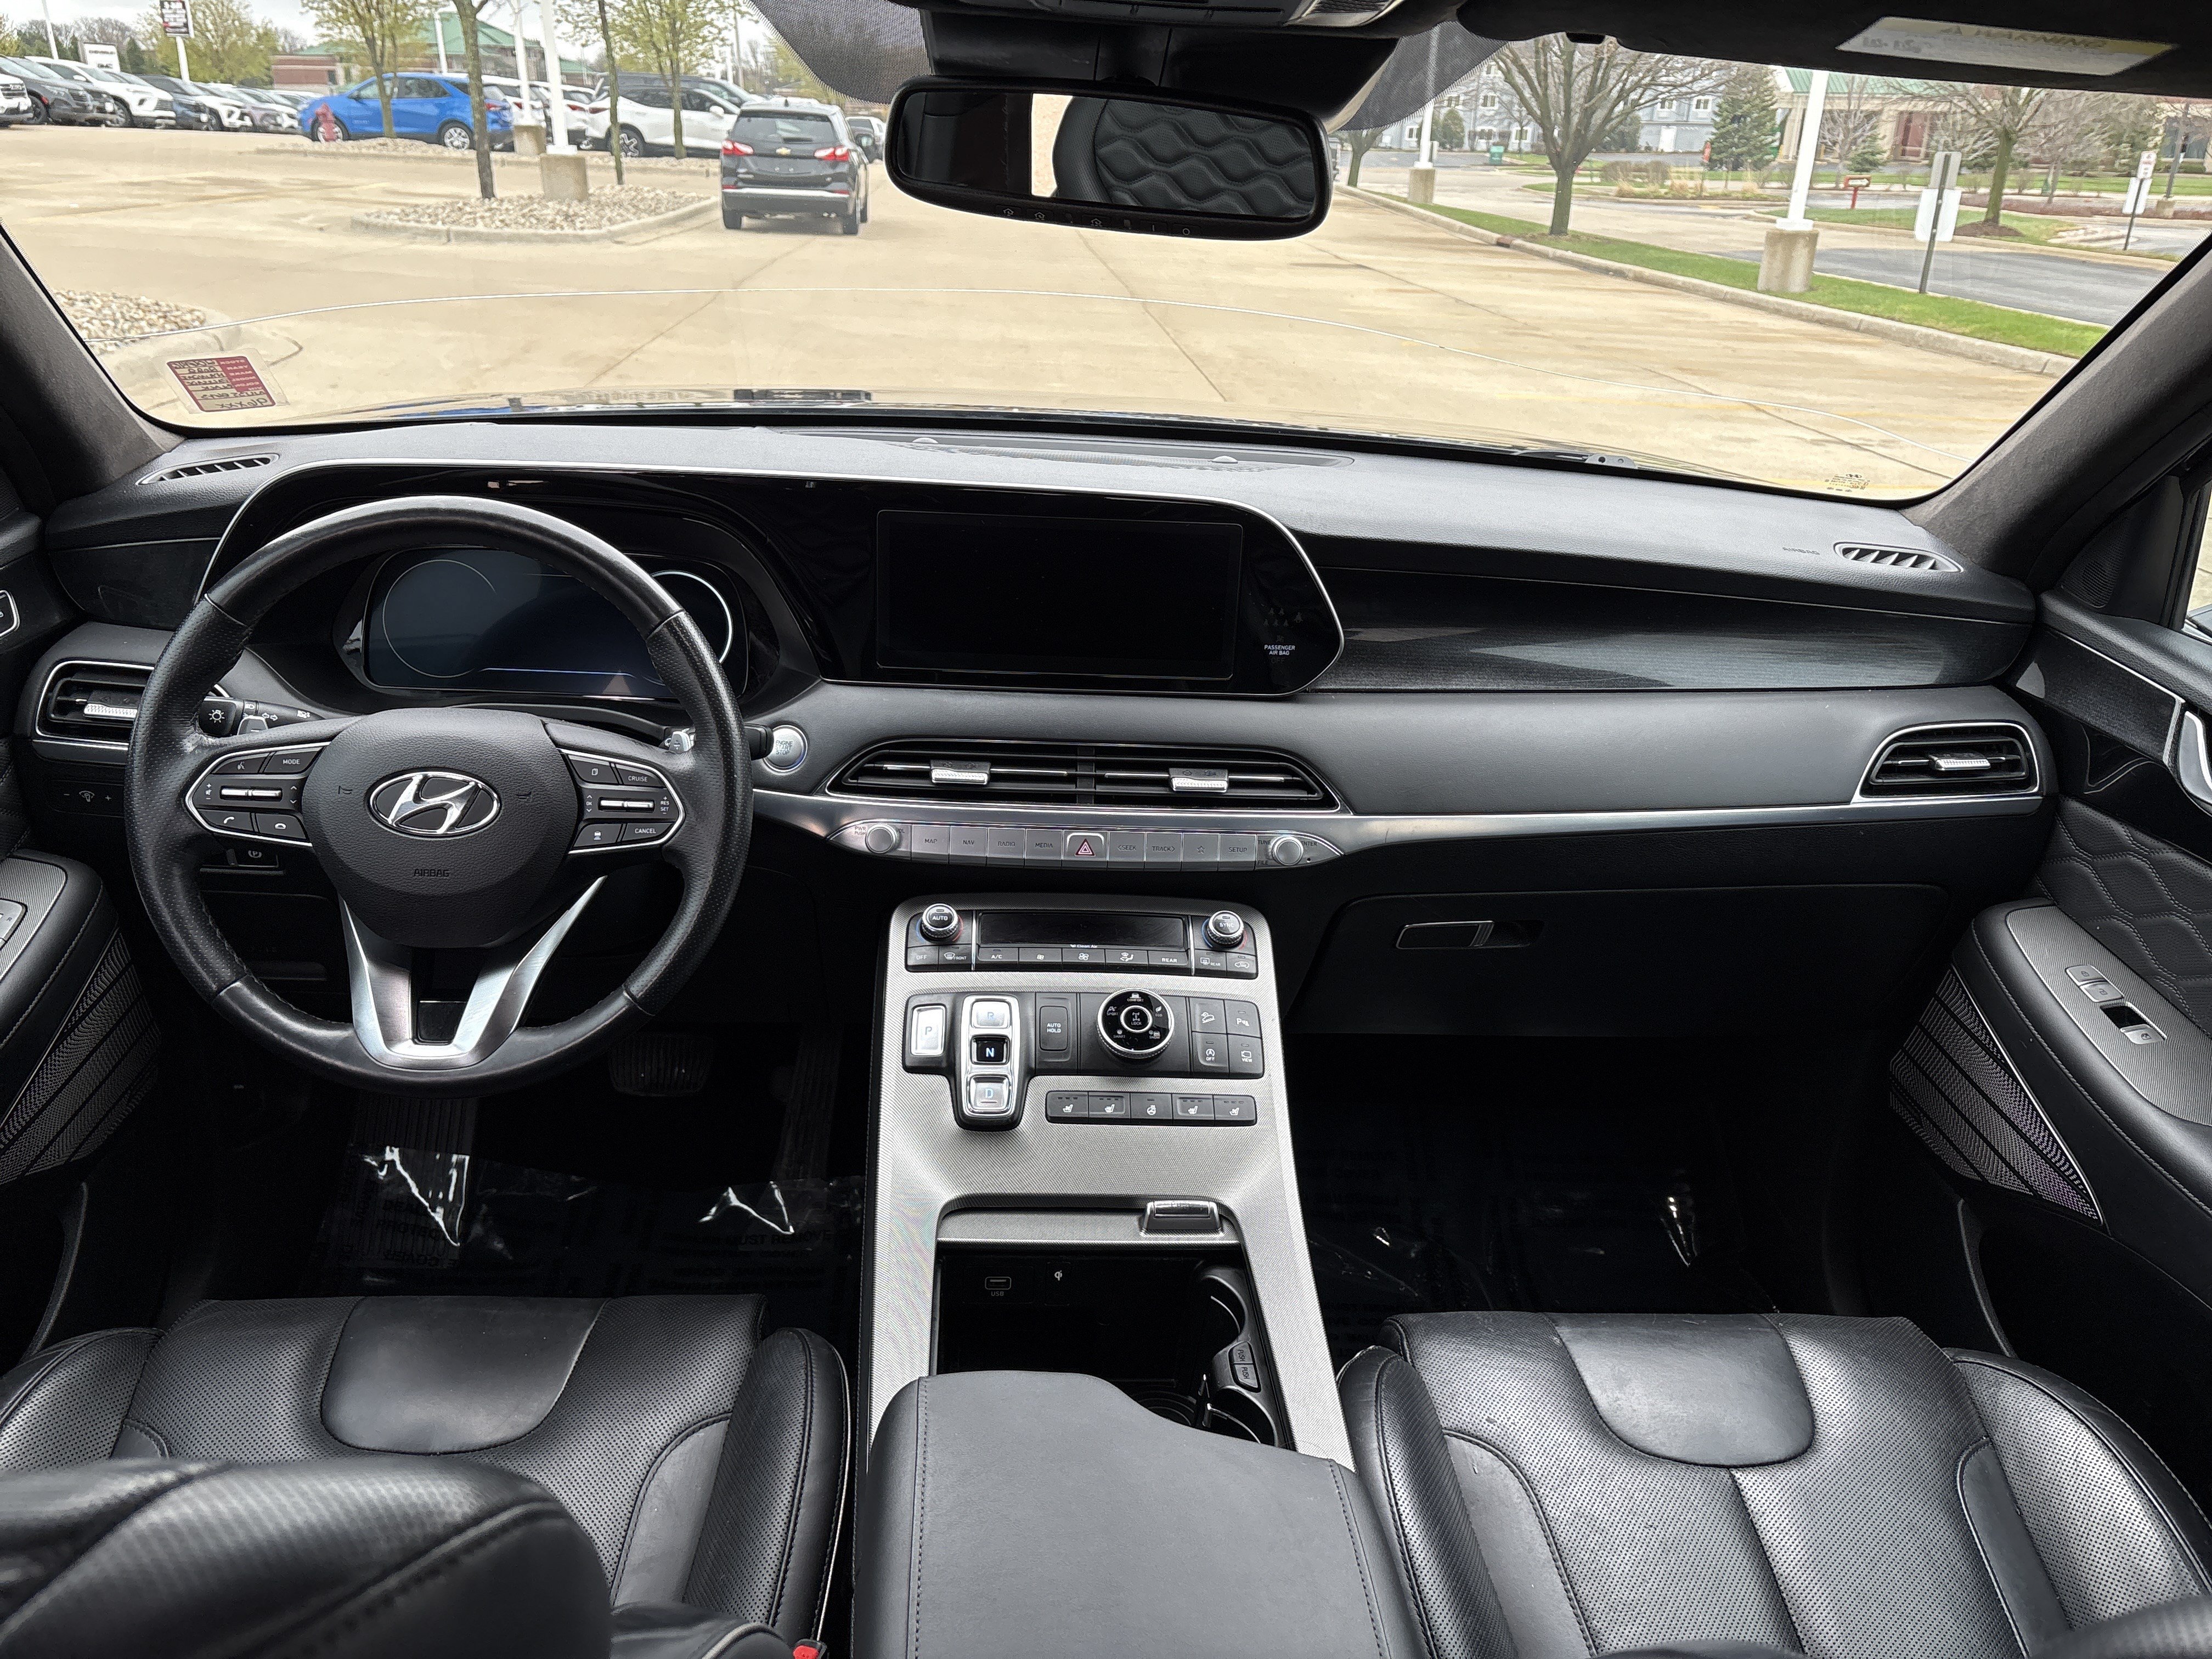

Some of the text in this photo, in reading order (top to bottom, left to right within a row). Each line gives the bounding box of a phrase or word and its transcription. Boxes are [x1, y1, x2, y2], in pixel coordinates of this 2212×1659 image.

[414, 868, 450, 877] AIRBAG
[988, 1012, 995, 1020] R
[924, 1026, 933, 1035] P
[985, 1047, 995, 1057] N
[985, 1088, 994, 1098] D
